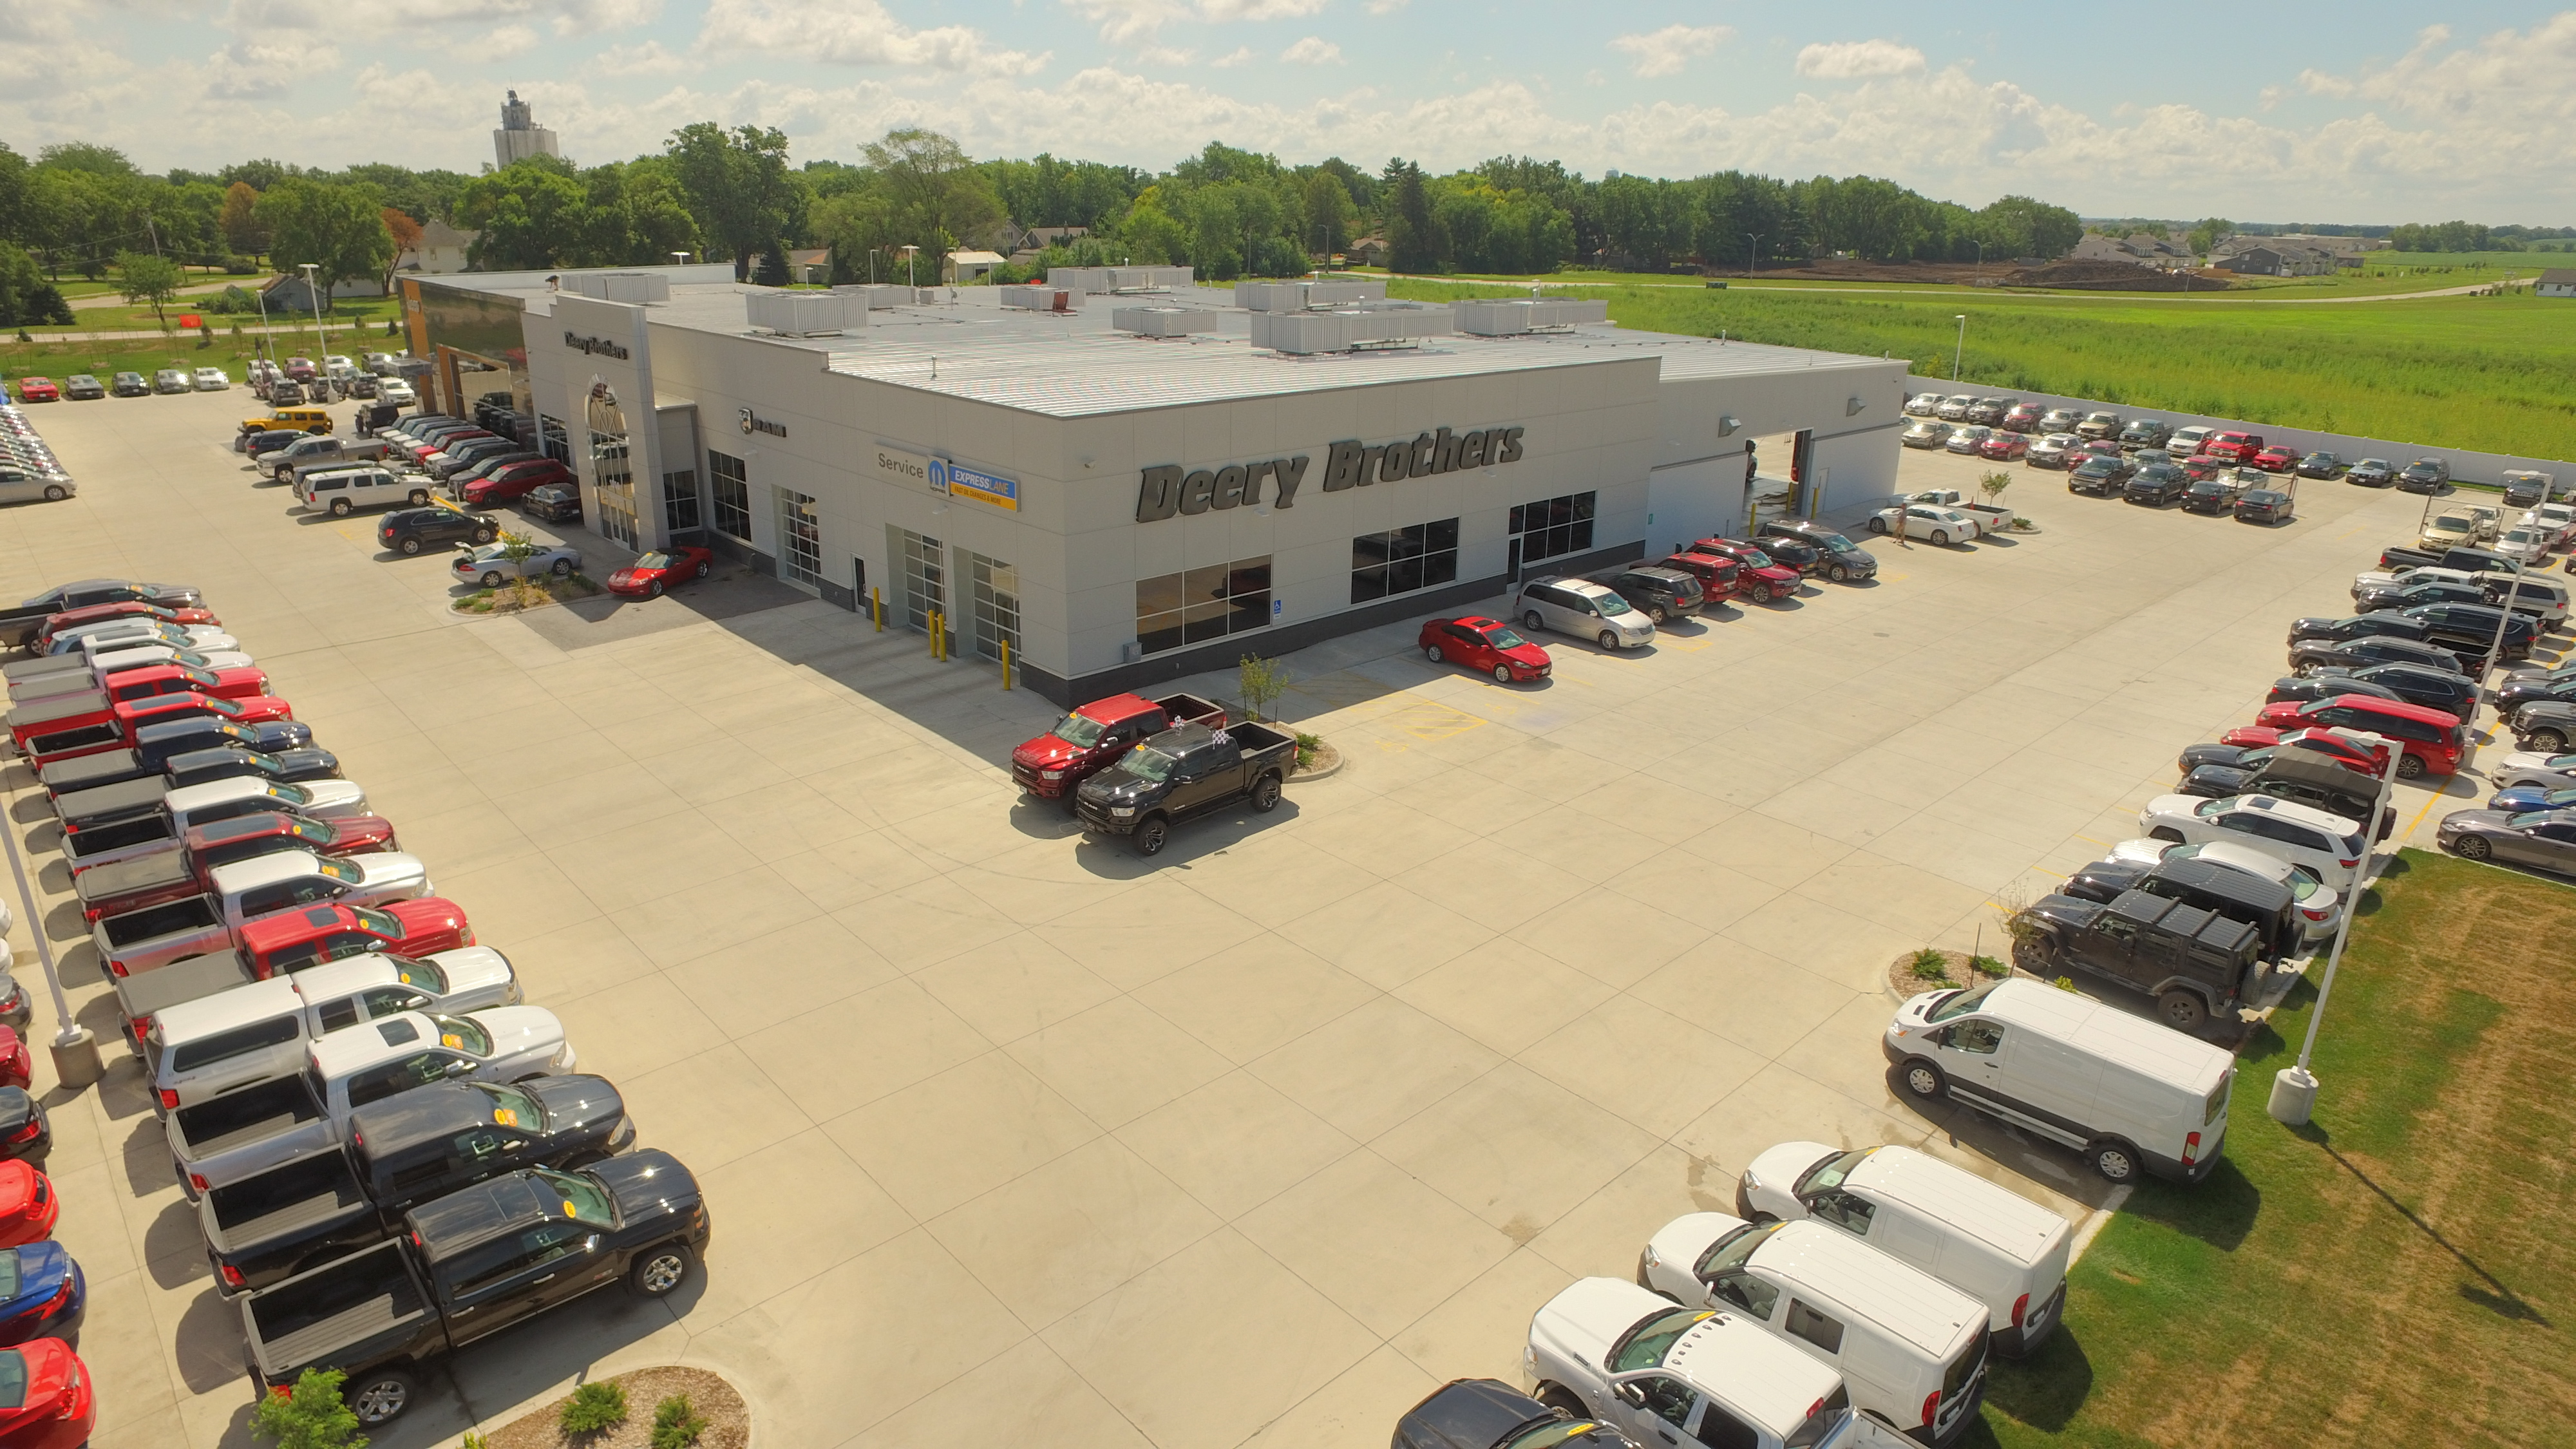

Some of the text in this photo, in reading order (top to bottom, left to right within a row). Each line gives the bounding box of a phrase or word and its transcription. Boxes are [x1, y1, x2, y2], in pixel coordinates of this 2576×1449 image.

[564, 331, 628, 359] Deery Brothers
[752, 419, 786, 438] RAM
[878, 453, 923, 478] Service
[1135, 427, 1524, 523] Deery Brothers
[969, 489, 986, 501] CHANGES
